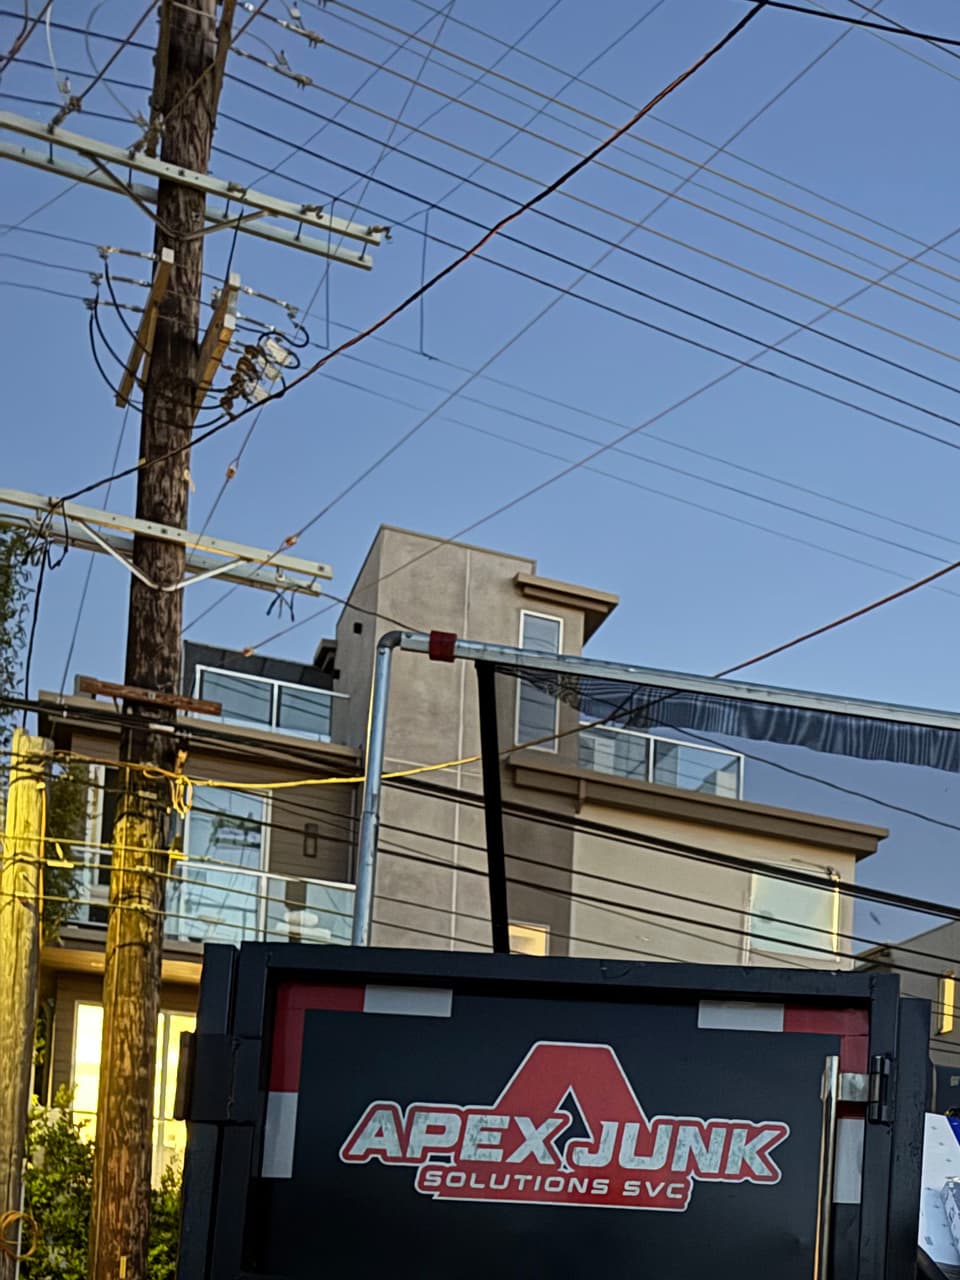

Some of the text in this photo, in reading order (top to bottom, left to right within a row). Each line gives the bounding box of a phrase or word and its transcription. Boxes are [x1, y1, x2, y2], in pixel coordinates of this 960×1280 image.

[348, 1109, 782, 1177] APEX JUNK
[423, 1170, 686, 1200] SOLUTIONS SVC
